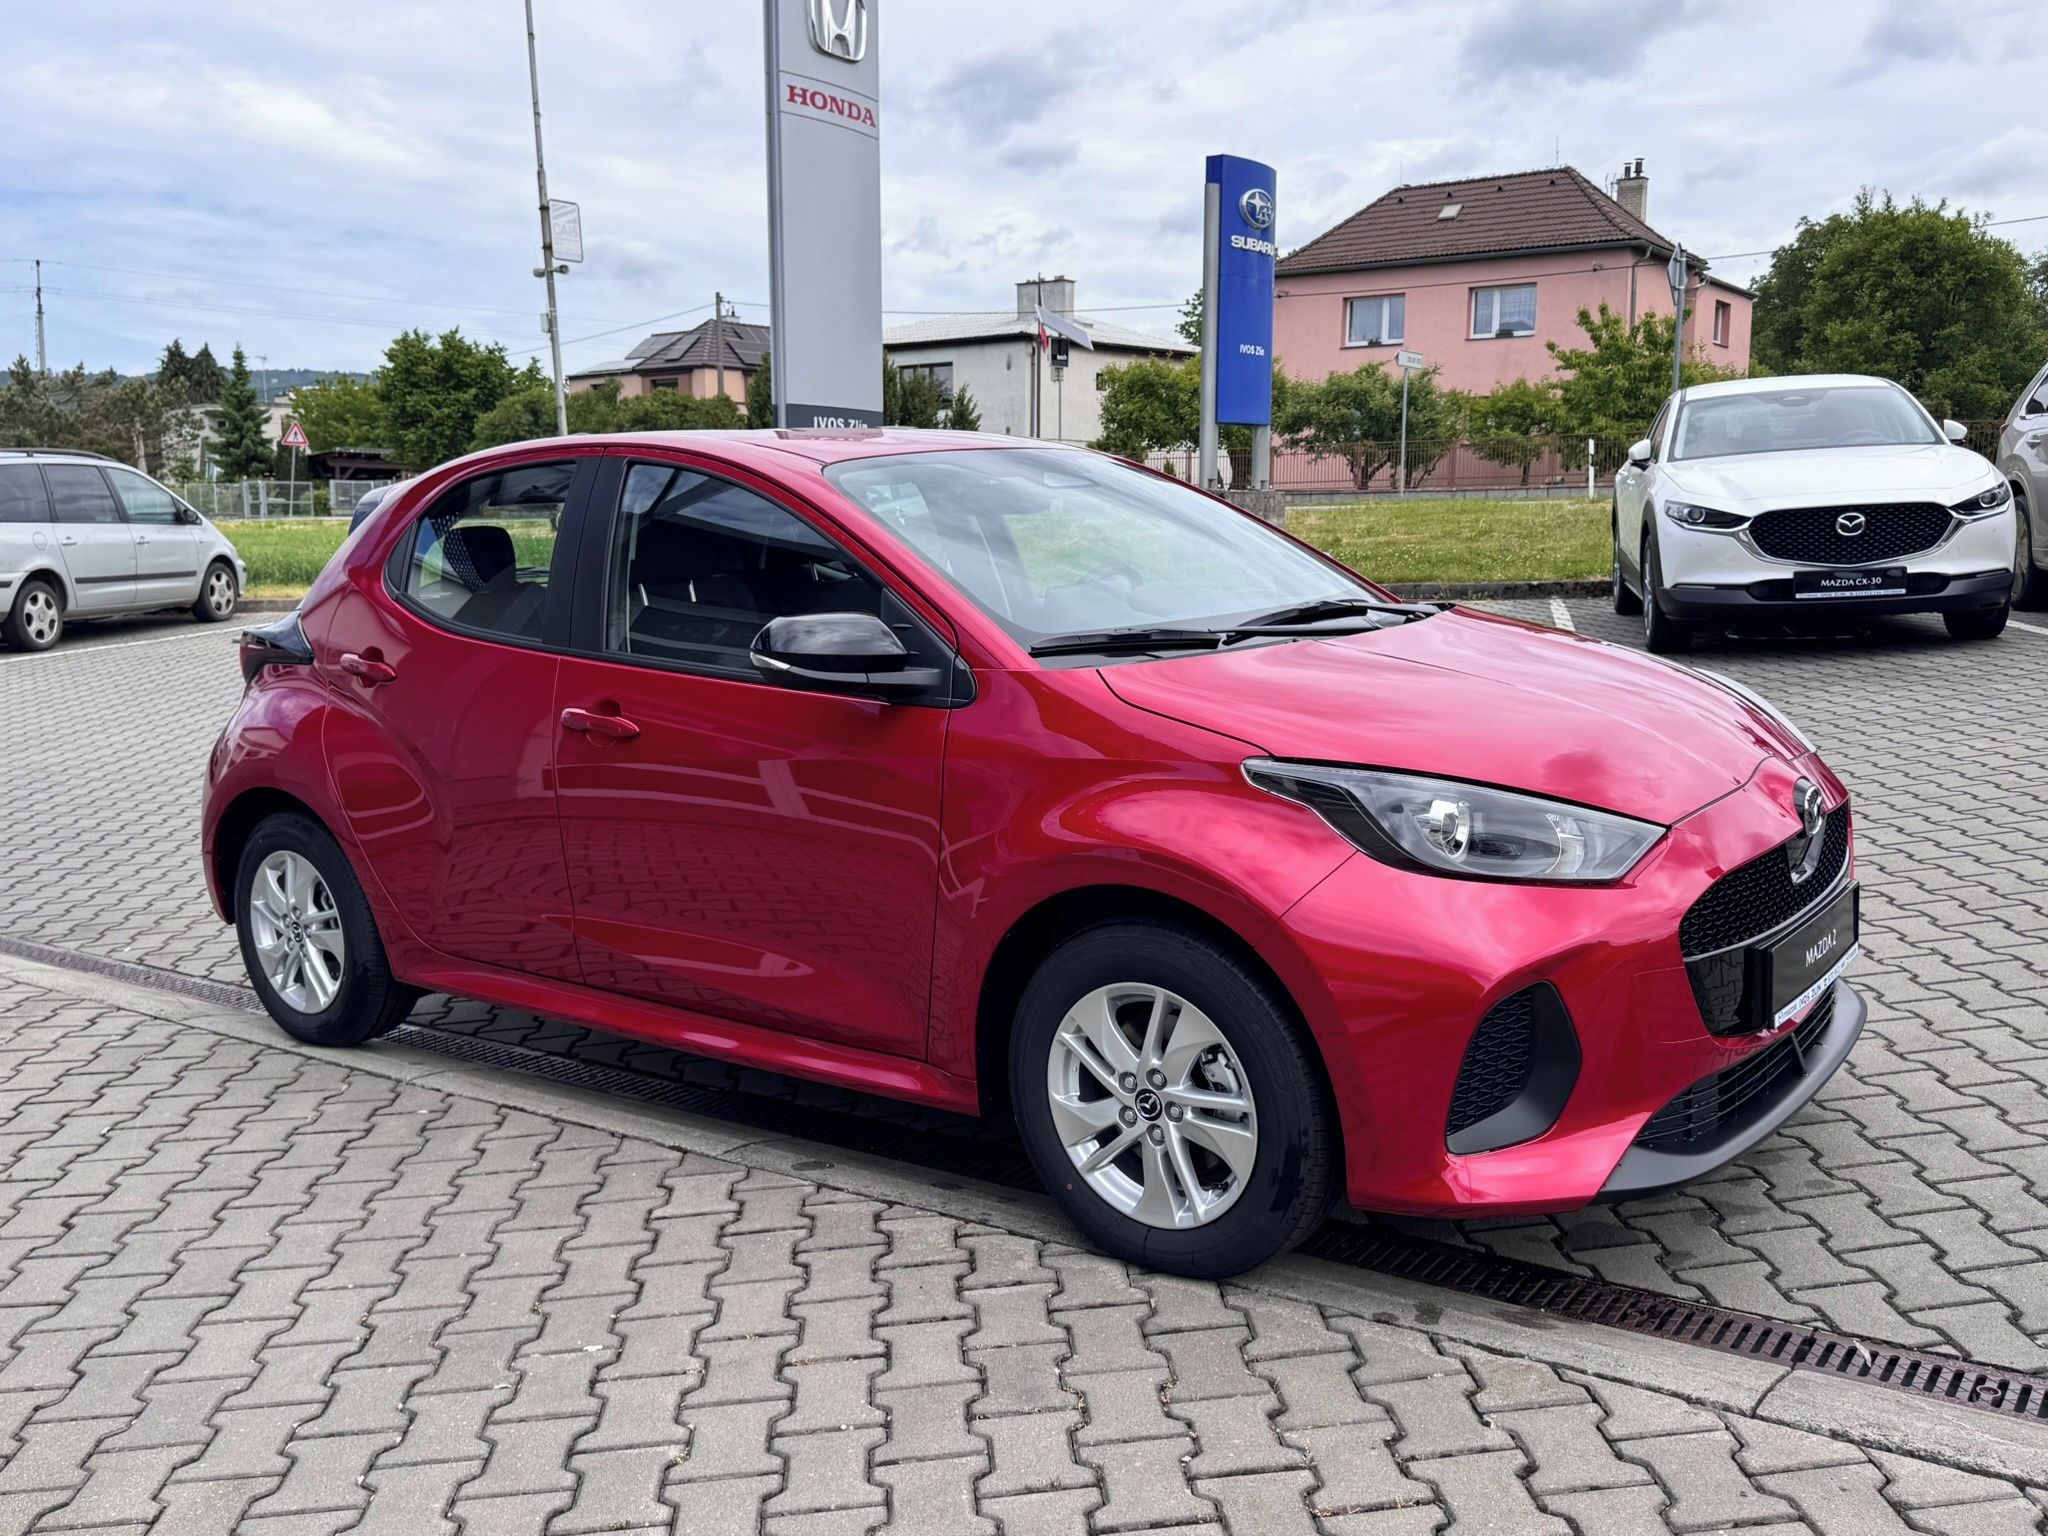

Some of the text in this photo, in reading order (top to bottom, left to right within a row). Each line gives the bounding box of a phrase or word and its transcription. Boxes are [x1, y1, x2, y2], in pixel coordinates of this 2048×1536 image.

[787, 84, 876, 128] HONDA
[813, 416, 845, 429] IVOS
[1820, 577, 1882, 587] MAZDA CX-30
[1805, 933, 1833, 968] MAZDA
[1832, 928, 1837, 946] 2
